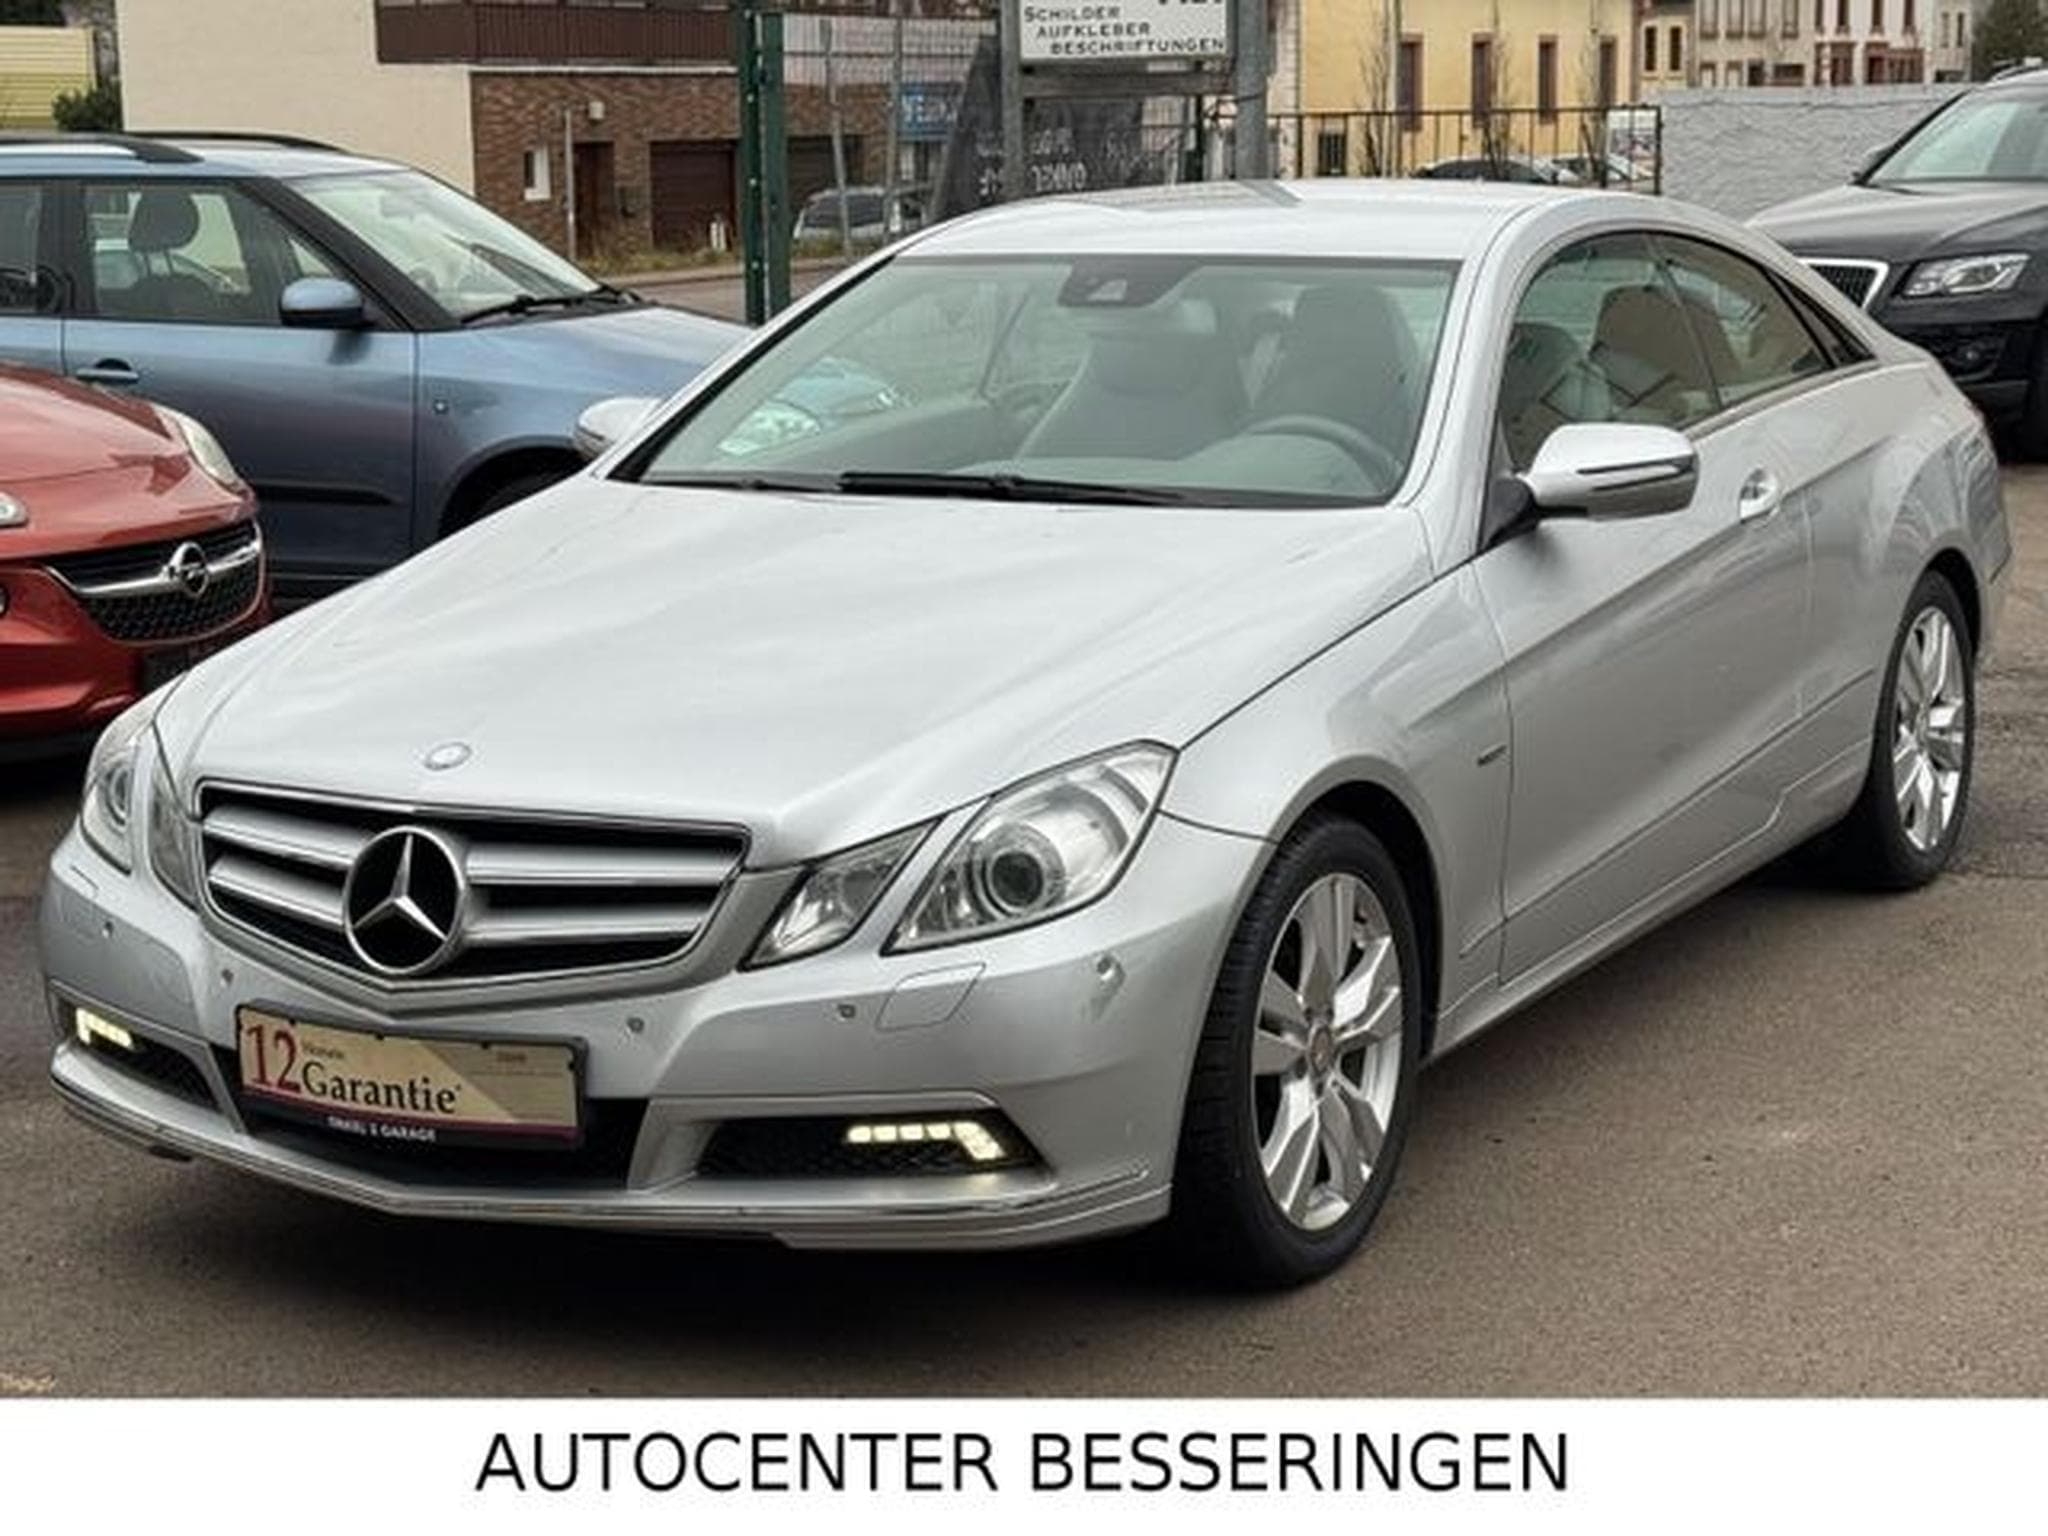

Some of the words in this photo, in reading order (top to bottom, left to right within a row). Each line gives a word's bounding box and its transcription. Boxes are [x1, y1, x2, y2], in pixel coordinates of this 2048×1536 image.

[1024, 6, 1121, 22] SCHILDER
[1037, 22, 1151, 38] AUFKLEBER
[1050, 38, 1224, 54] BESCHRIFTUNGEN
[247, 1022, 302, 1092] 12
